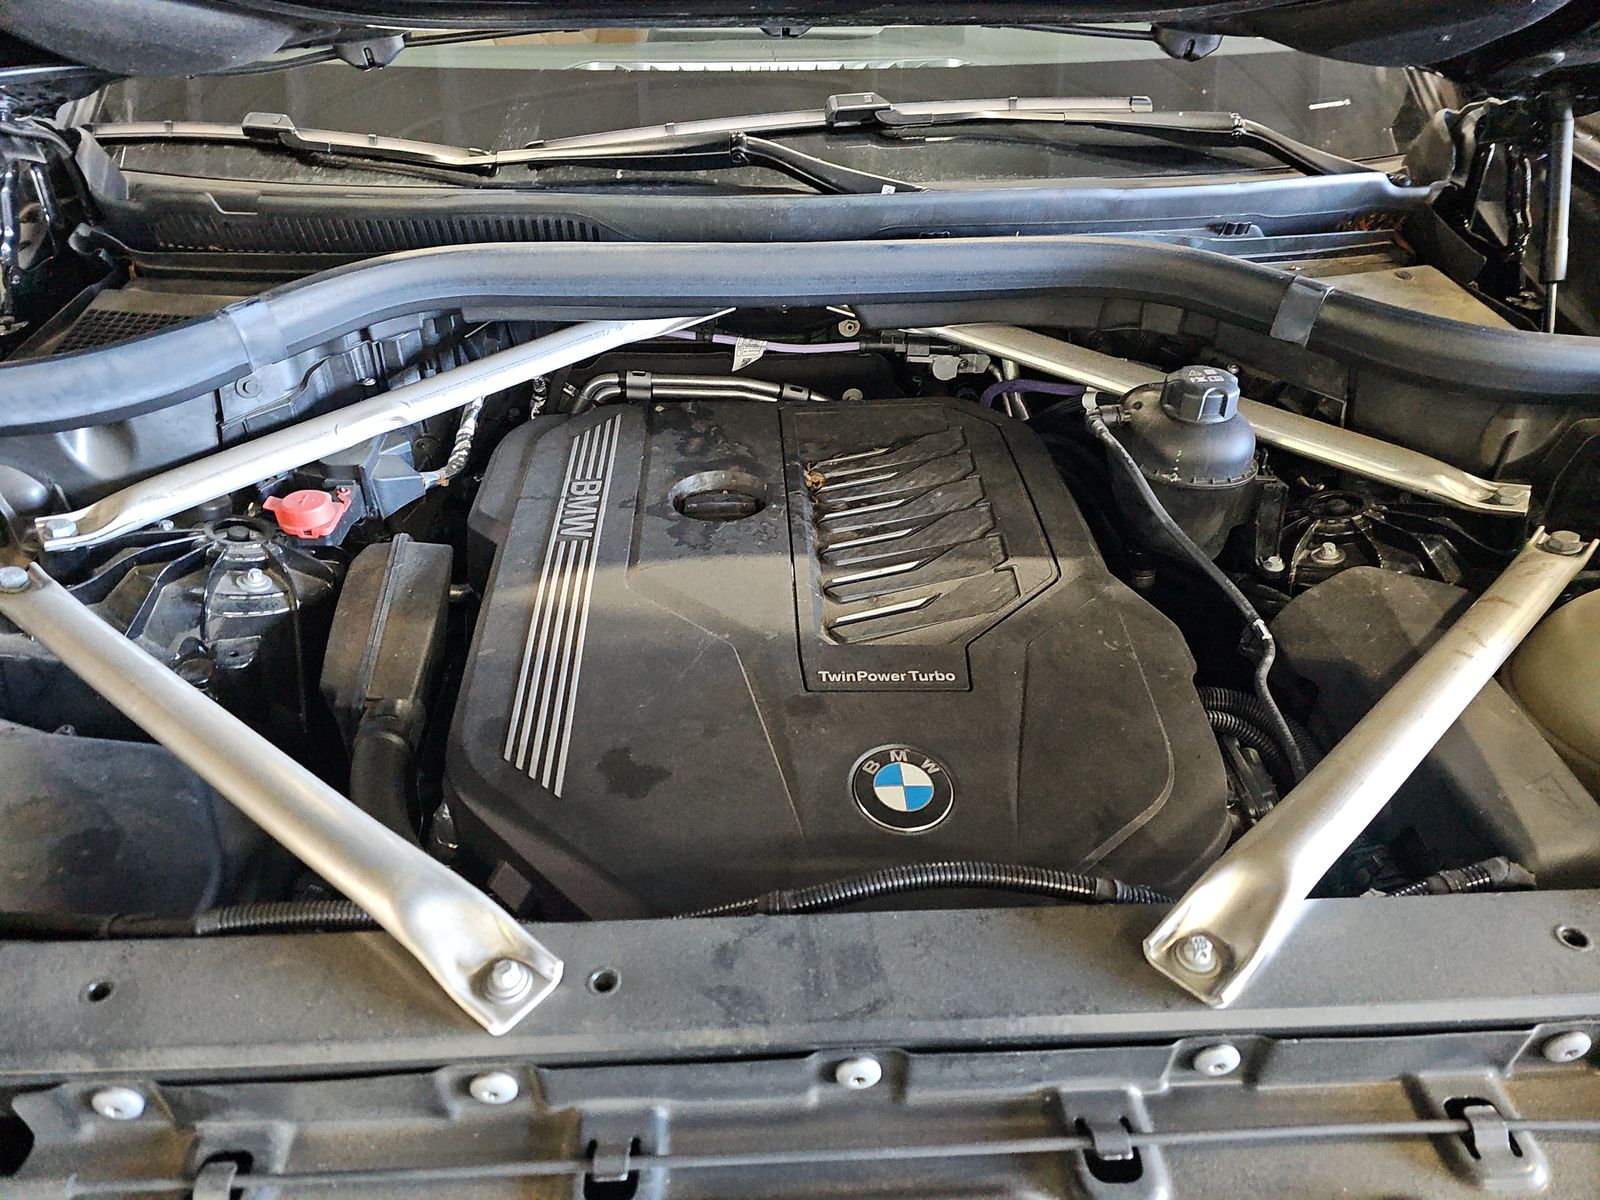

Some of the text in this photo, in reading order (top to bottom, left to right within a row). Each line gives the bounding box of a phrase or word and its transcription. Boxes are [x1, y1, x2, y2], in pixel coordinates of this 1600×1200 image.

[560, 480, 603, 538] BMW
[817, 670, 956, 683] TwinPower Turbo
[862, 749, 941, 775] BMW
